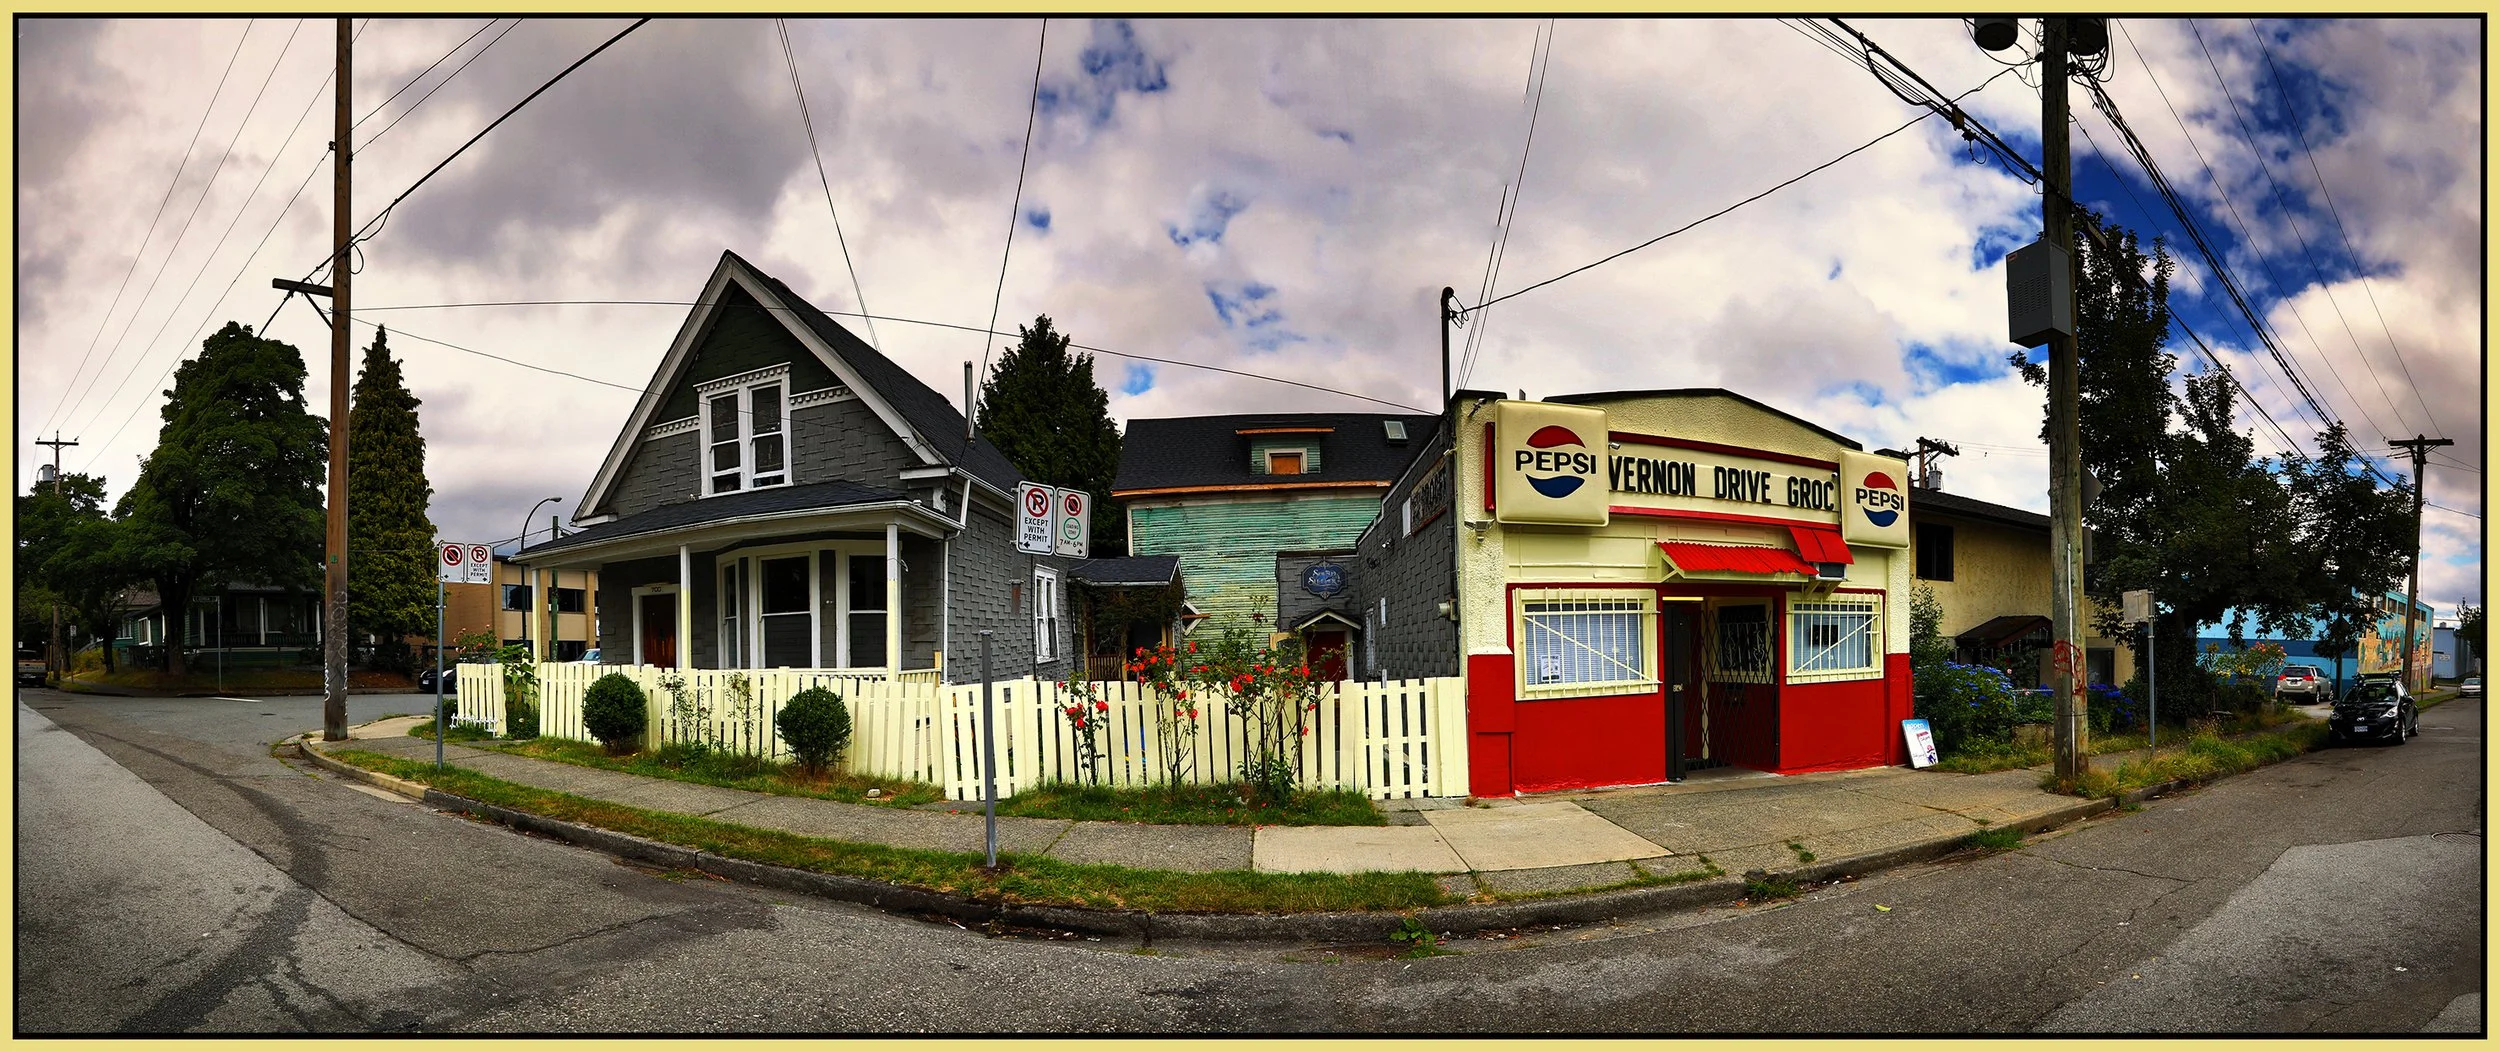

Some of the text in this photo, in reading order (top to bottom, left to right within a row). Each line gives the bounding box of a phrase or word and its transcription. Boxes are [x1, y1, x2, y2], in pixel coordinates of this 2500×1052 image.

[1515, 450, 1597, 475] PEPSI
[1608, 455, 1835, 511] VERNON DRIVE GROC
[1855, 488, 1905, 511] PEPSI
[1024, 517, 1048, 526] EXCEPT
[1028, 525, 1044, 534] WITH
[1024, 533, 1048, 542] PERMIT
